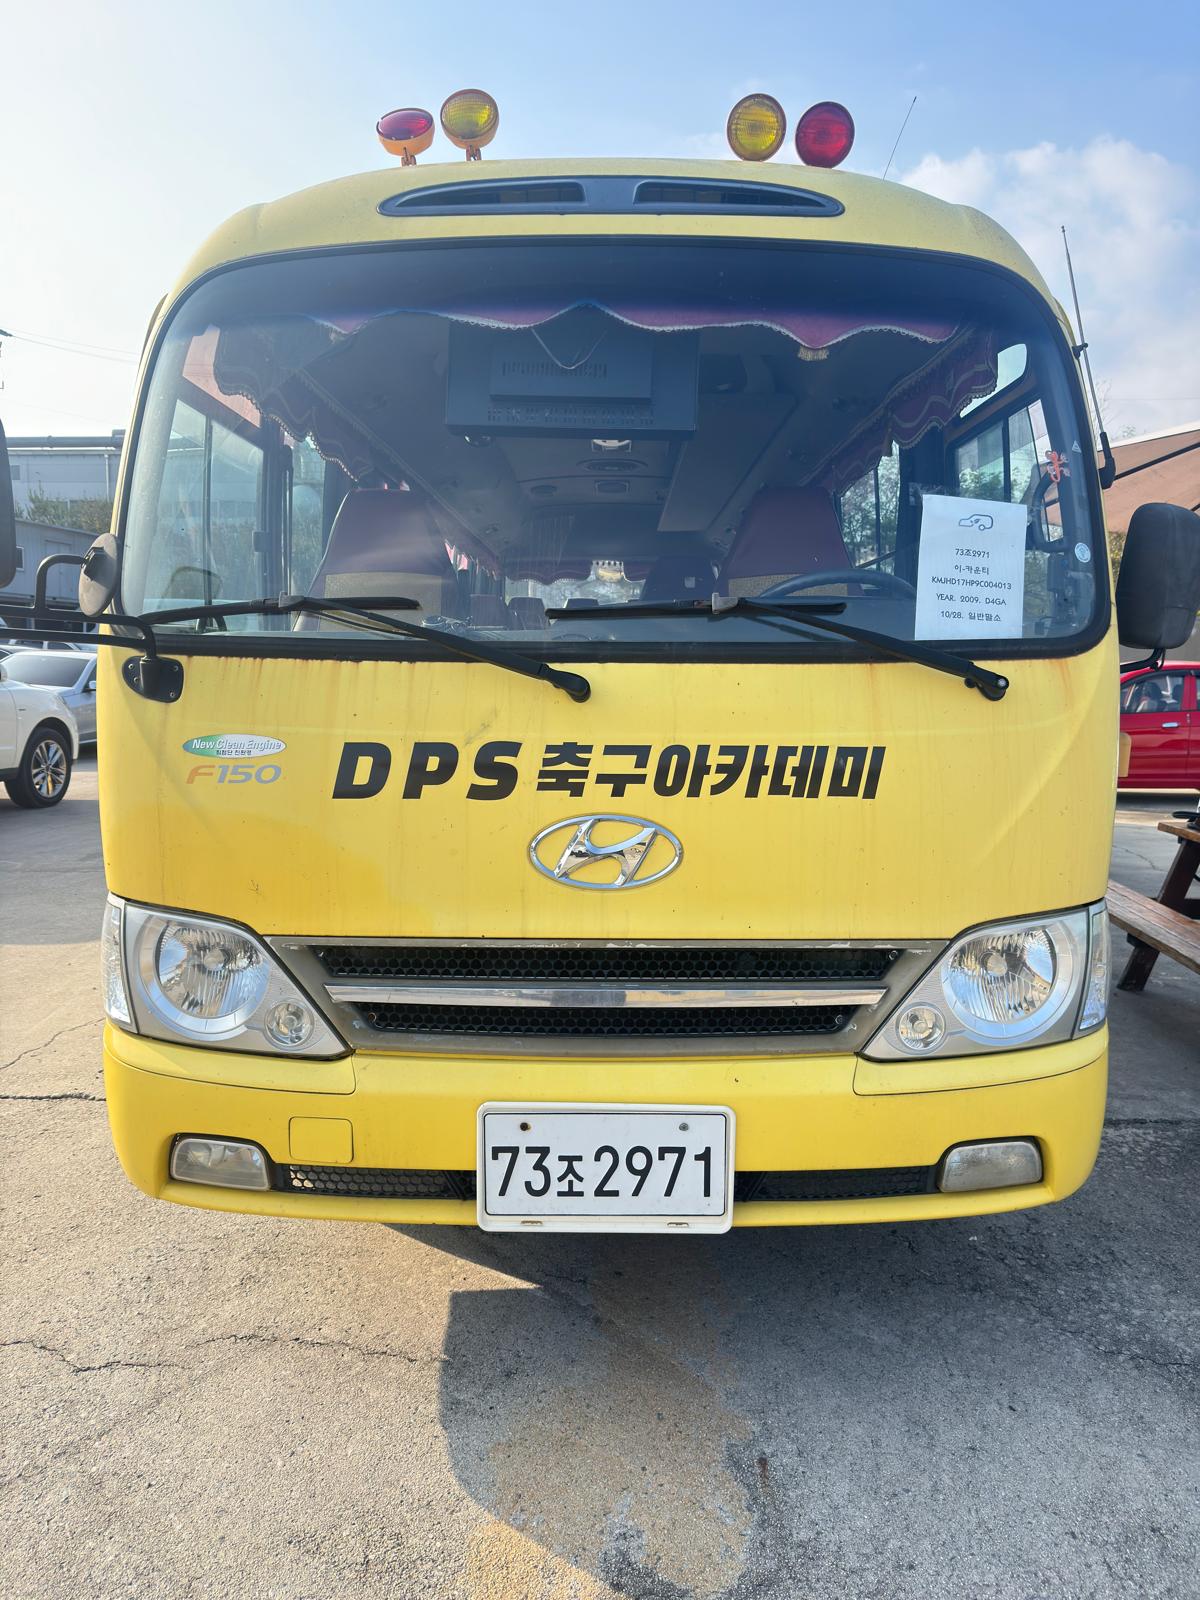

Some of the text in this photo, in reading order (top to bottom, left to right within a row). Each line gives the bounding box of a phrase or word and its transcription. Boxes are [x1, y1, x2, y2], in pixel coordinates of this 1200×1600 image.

[955, 548, 990, 559] 73조2971
[954, 564, 989, 575] 이-카운티
[931, 576, 1012, 590] KMJHD17HP9C004013
[936, 593, 1007, 606] YEAR. 2009. D4GA
[968, 612, 1002, 622] 일반말소
[192, 739, 282, 752] New Clean Engine
[185, 764, 282, 785] F150
[332, 741, 887, 801] DPS 축구아카데미
[491, 1145, 712, 1198] 73조2971
